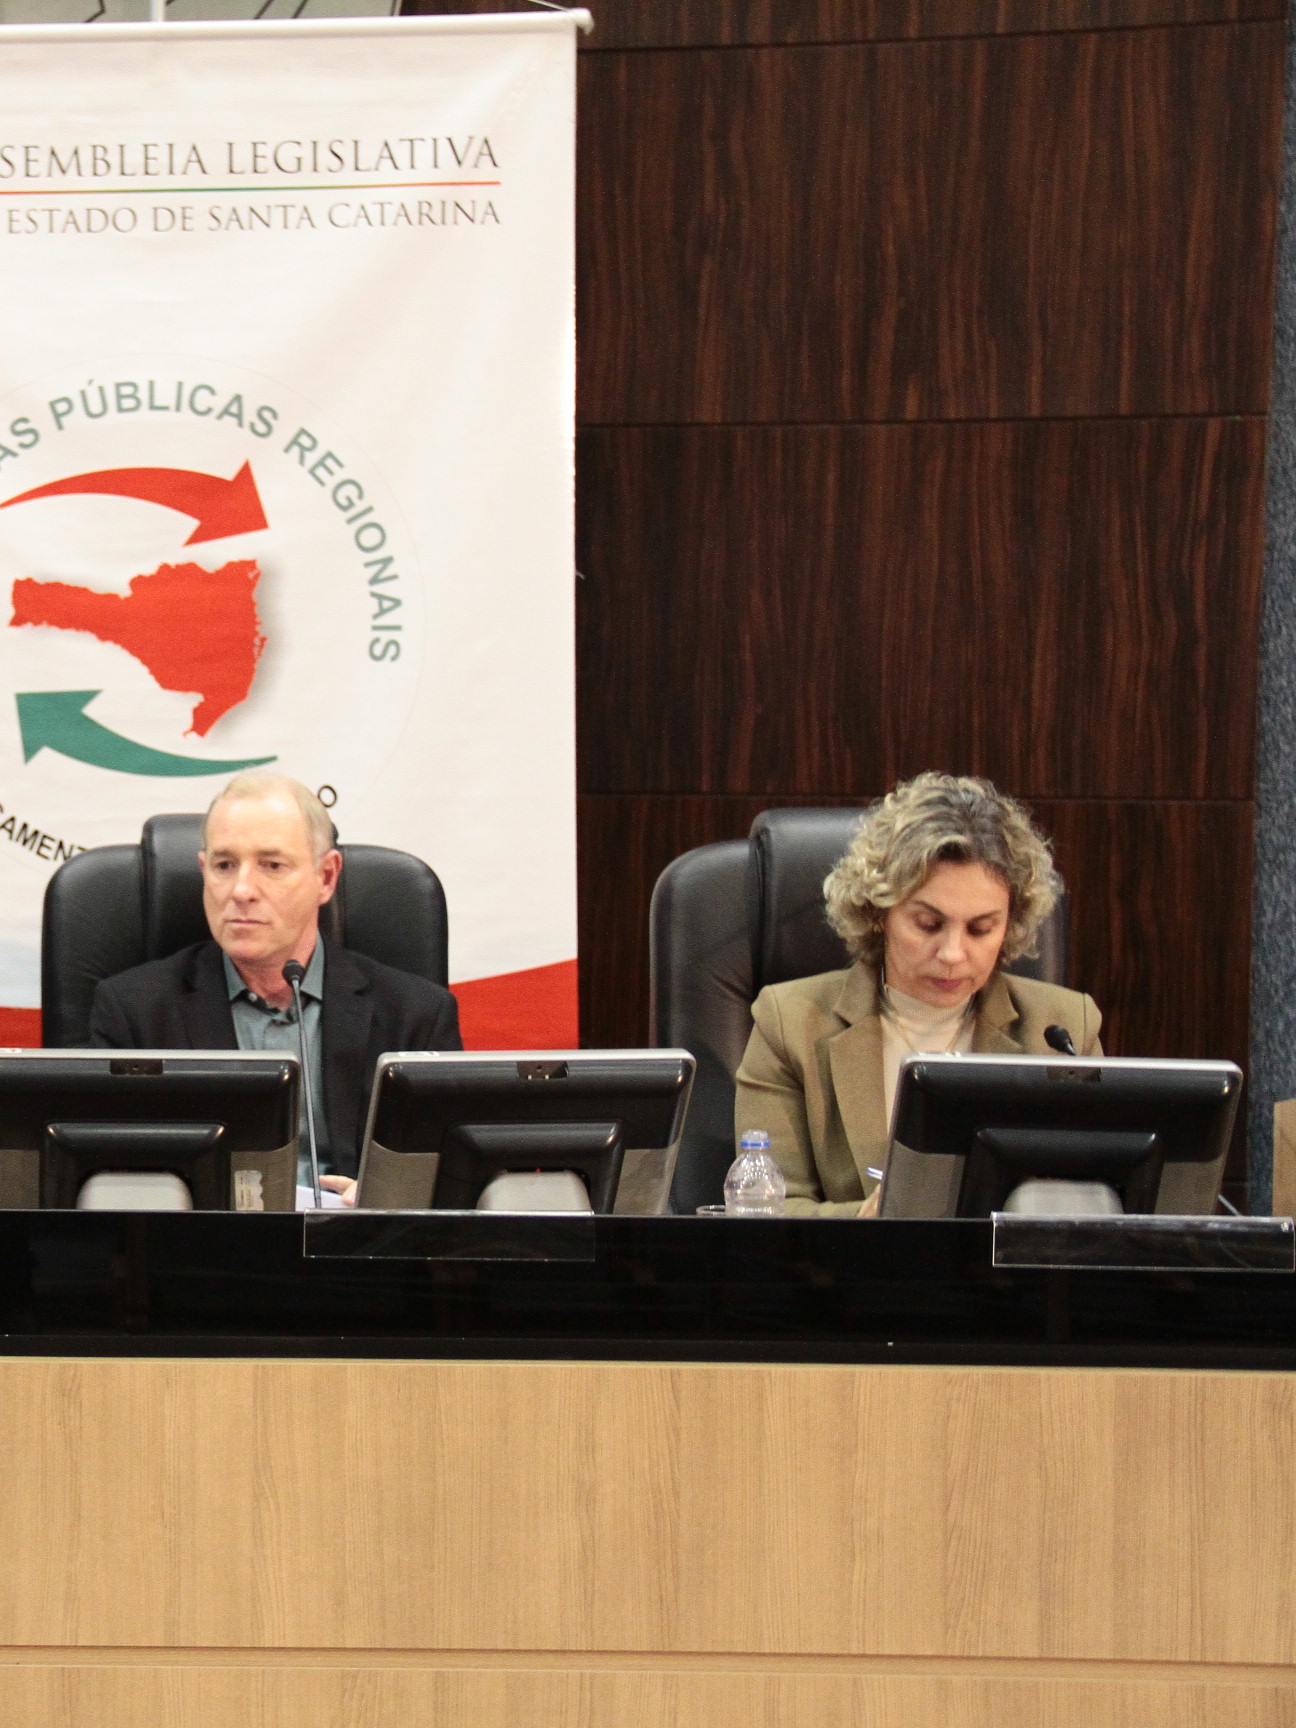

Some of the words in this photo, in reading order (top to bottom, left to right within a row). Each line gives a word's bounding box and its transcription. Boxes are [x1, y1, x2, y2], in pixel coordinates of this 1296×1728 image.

[226, 136, 500, 176] LEGISLATIVA
[7, 205, 138, 235] ESTADO
[153, 206, 196, 232] DE
[208, 203, 316, 232] SANTA
[328, 198, 501, 230] CATARINA
[49, 379, 279, 439] PÚBLICAS
[283, 427, 403, 663] REGIONAIS
